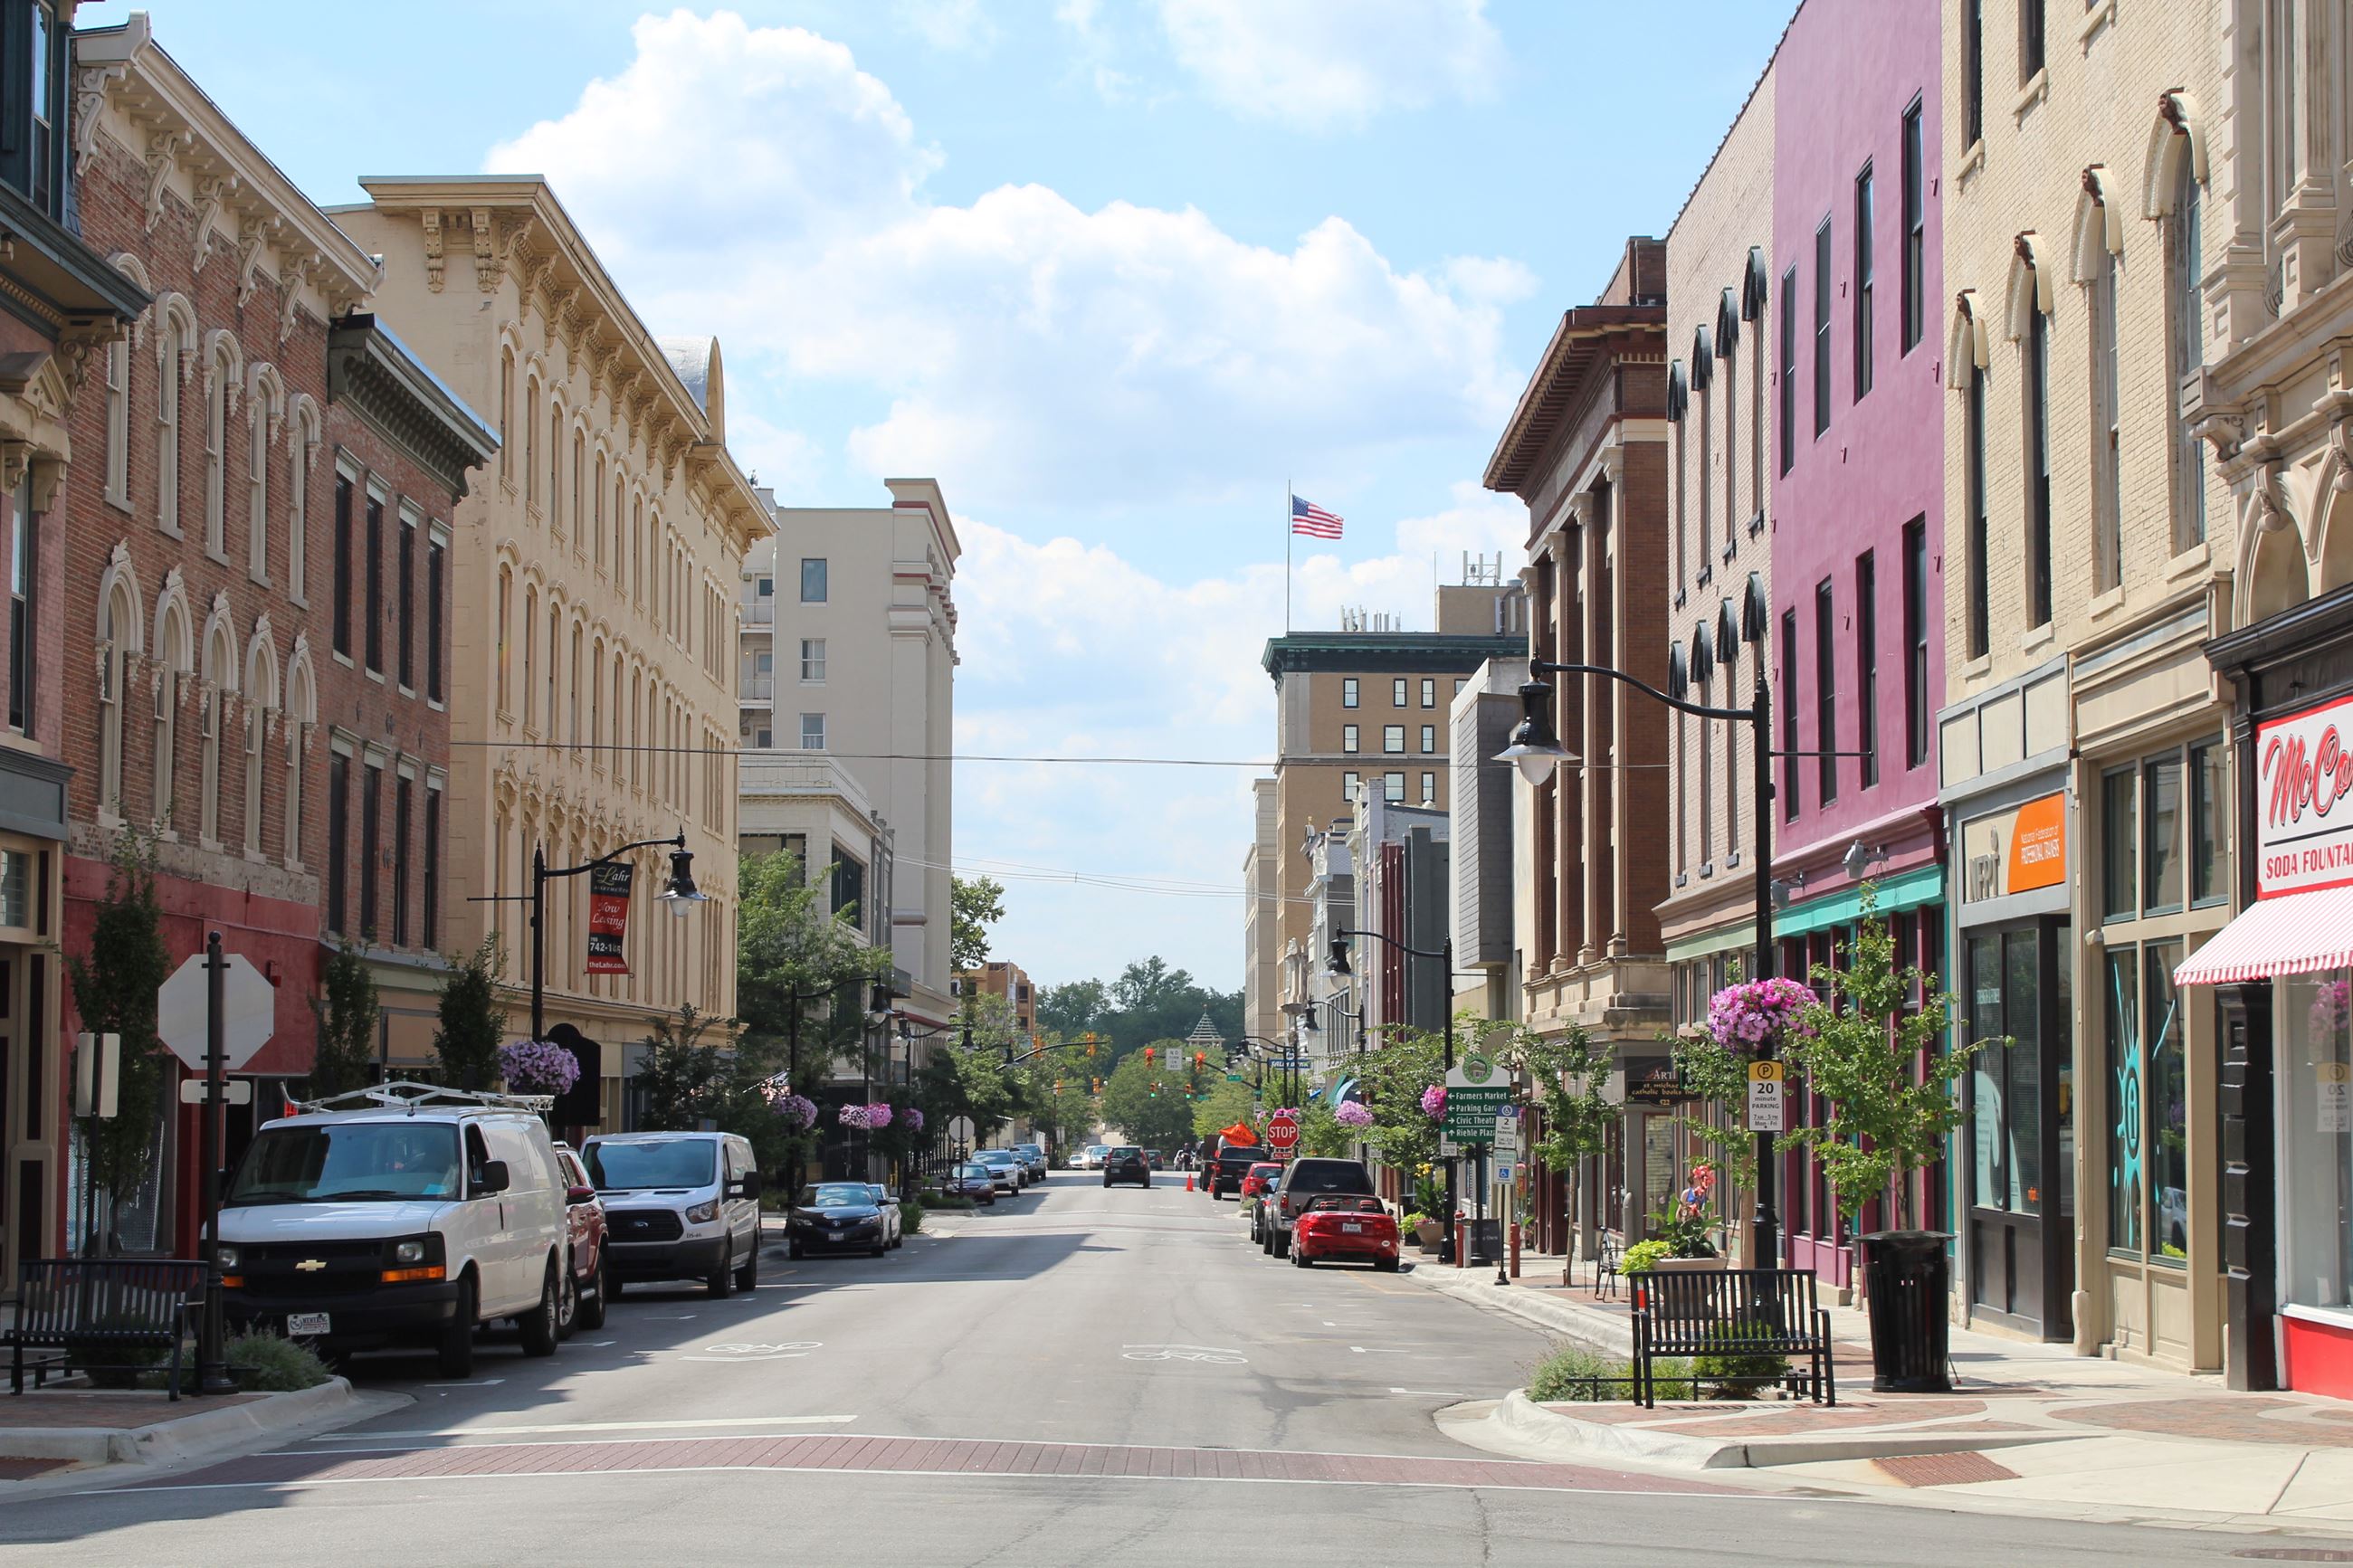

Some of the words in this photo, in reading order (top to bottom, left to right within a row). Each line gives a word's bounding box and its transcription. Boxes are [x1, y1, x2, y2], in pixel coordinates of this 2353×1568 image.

[2266, 853, 2298, 879] SODA
[594, 866, 631, 886] Lahr
[1758, 1083, 1774, 1094] 20
[1455, 1092, 1483, 1100] Farmers
[1484, 1092, 1507, 1100] Market
[1456, 1104, 1481, 1114] Parking
[1456, 1117, 1472, 1125] Civic
[1474, 1117, 1495, 1125] Theatr
[1503, 1117, 1510, 1126] 2
[1269, 1126, 1296, 1138] STOP
